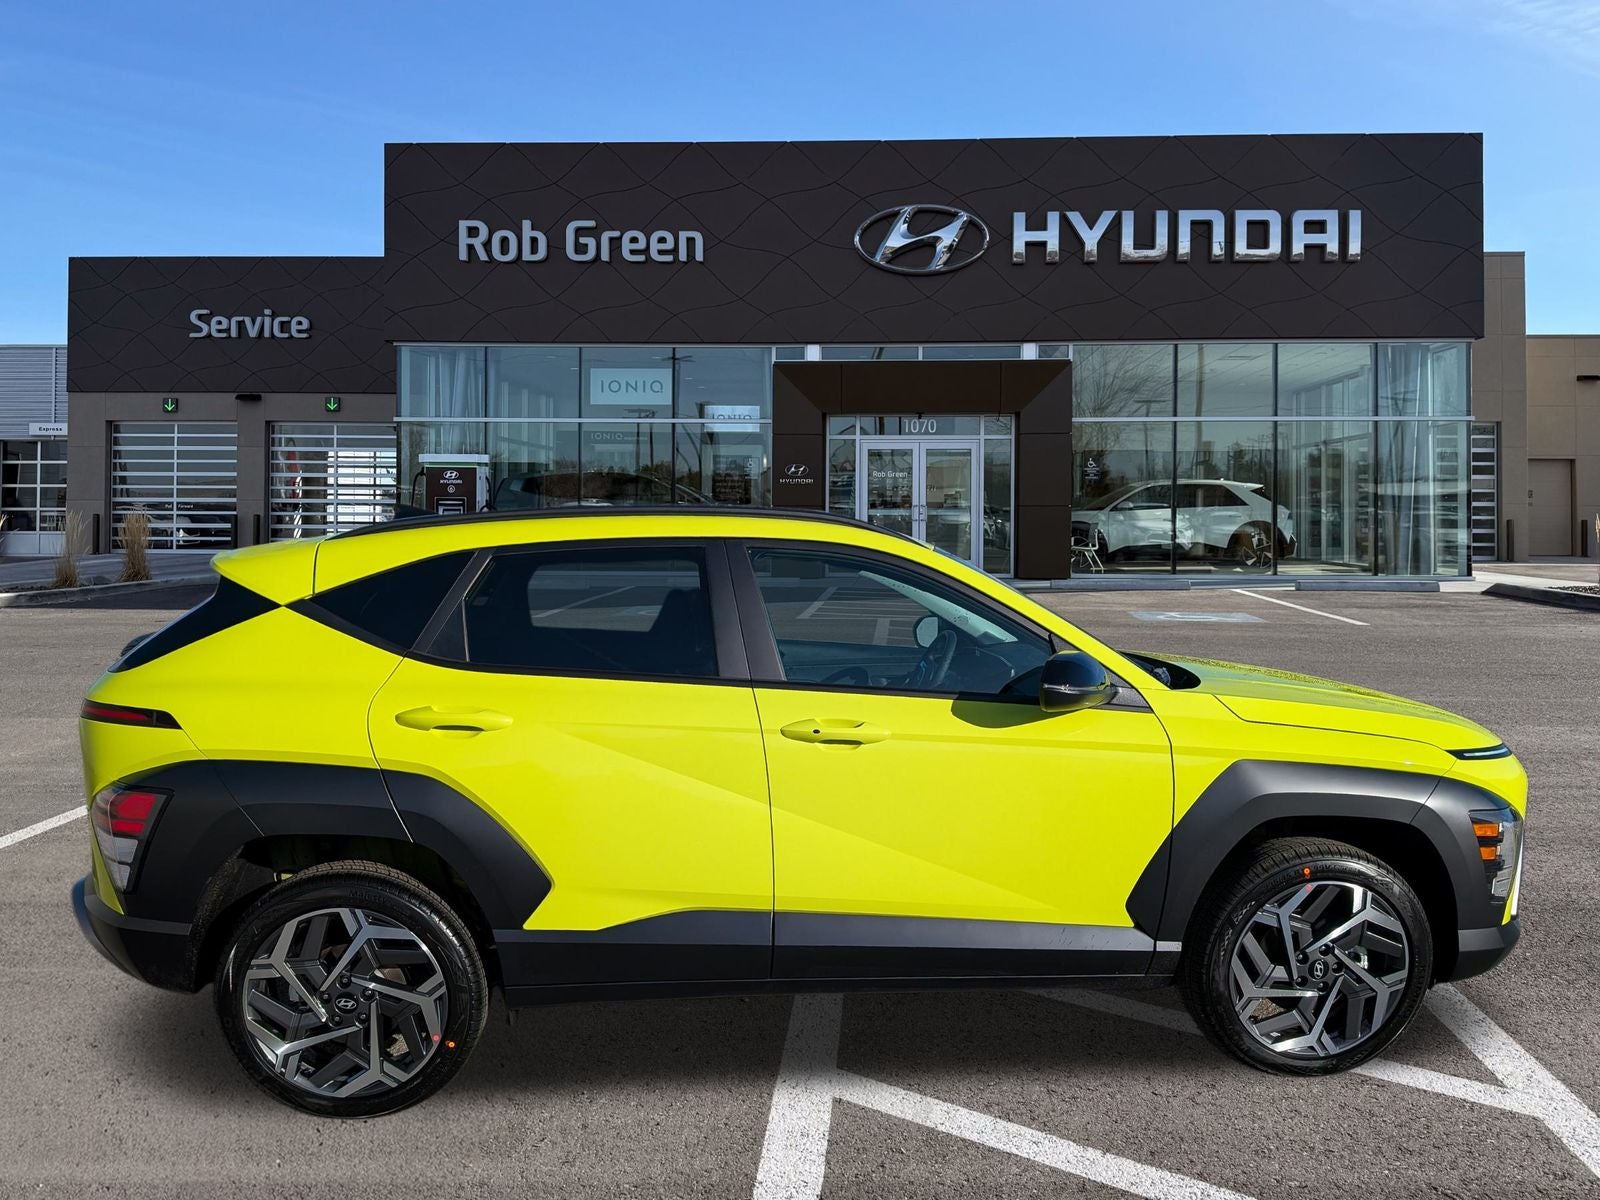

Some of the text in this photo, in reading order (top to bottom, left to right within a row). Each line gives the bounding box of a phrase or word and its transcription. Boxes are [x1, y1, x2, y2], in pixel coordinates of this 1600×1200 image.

[458, 219, 704, 262] Rob Green
[1011, 209, 1362, 264] HYUNDAI
[189, 308, 311, 338] Service
[600, 379, 664, 393] IONIQ
[591, 432, 623, 440] IONIQ
[903, 419, 937, 433] 1070
